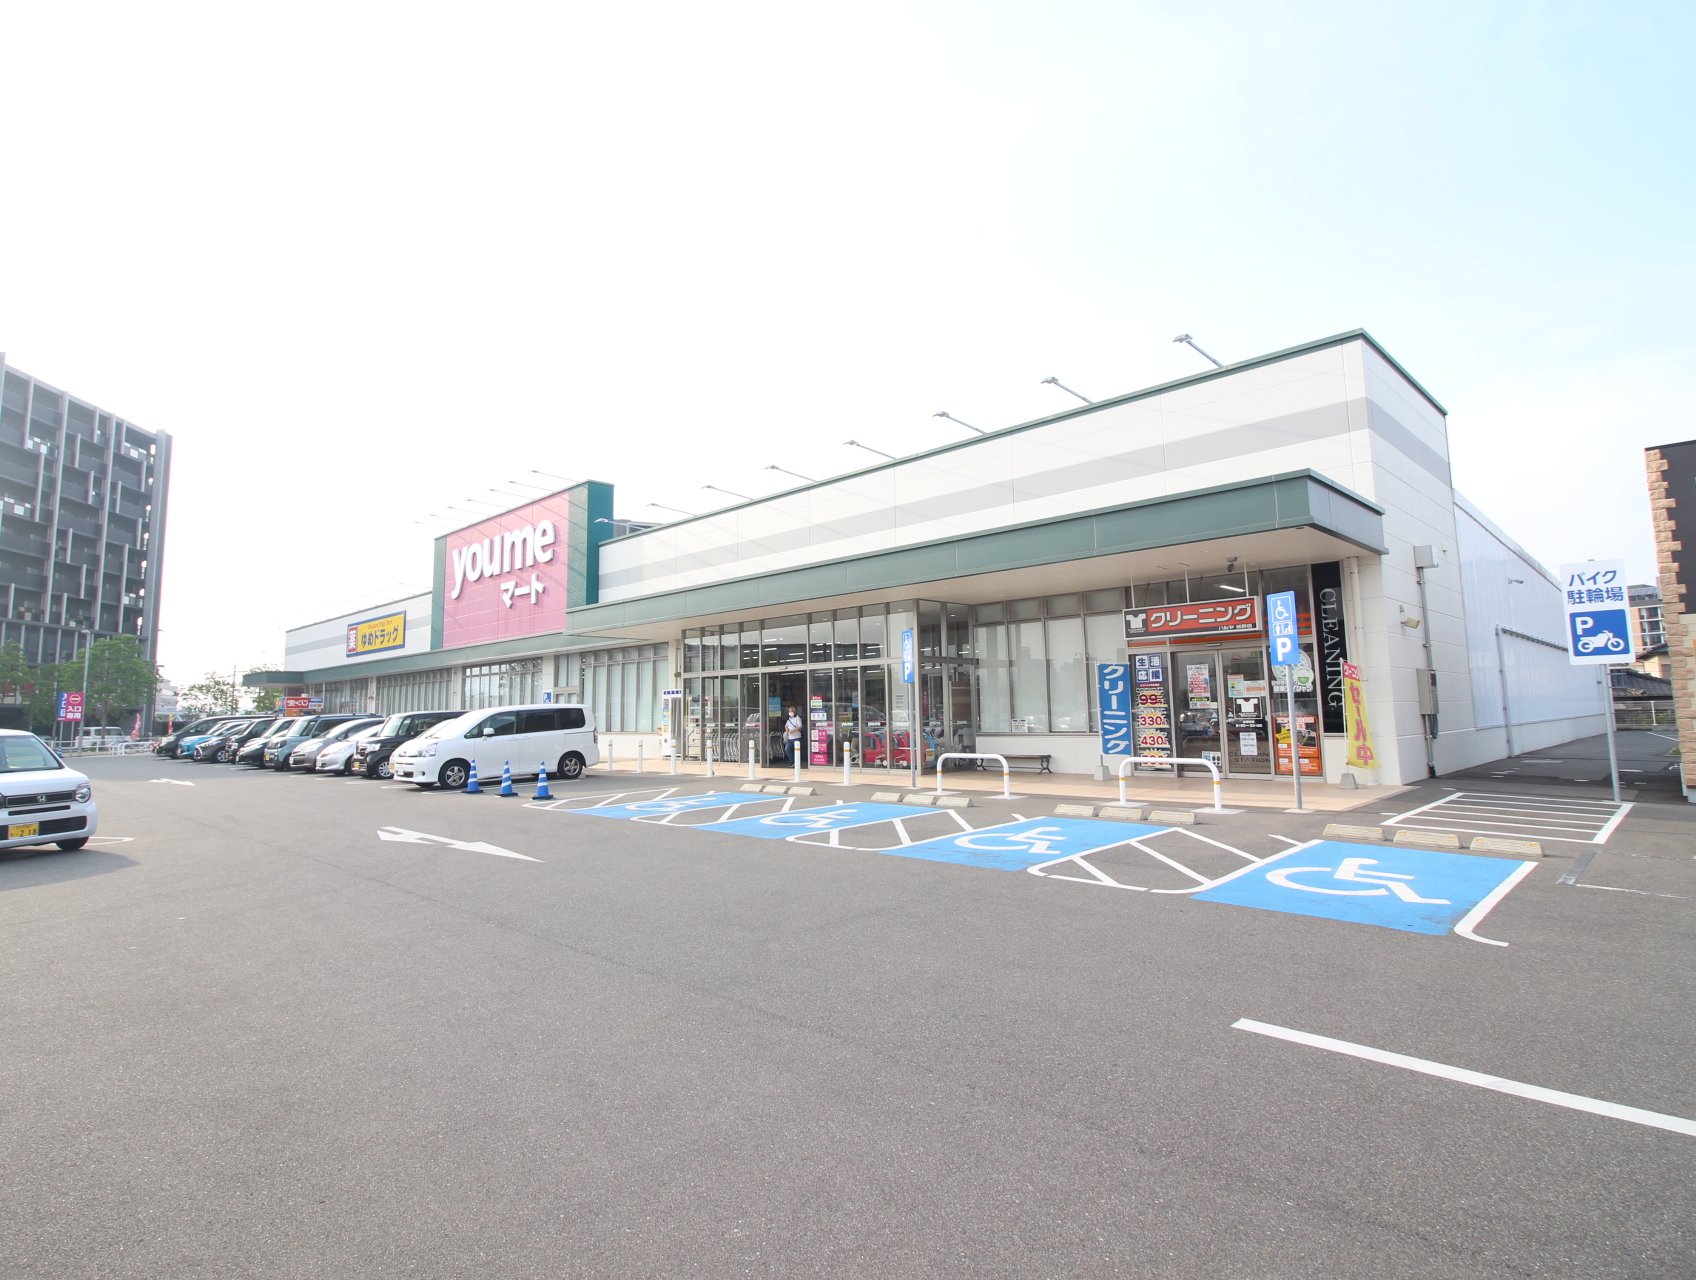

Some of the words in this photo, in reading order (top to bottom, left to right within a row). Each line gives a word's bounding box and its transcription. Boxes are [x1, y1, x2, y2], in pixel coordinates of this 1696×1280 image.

[451, 520, 556, 600] youme
[500, 573, 545, 608] マート
[1568, 570, 1617, 587] バイク
[1567, 586, 1624, 605] 駐輪場
[1150, 603, 1252, 628] クリーニング
[1575, 616, 1594, 635] P
[361, 624, 400, 648] ゆめドラッグ
[1320, 588, 1344, 707] CLEANING
[1276, 637, 1292, 662] P
[903, 662, 911, 680] P
[66, 705, 82, 713] 入口
[1103, 665, 1129, 754] クリーニング
